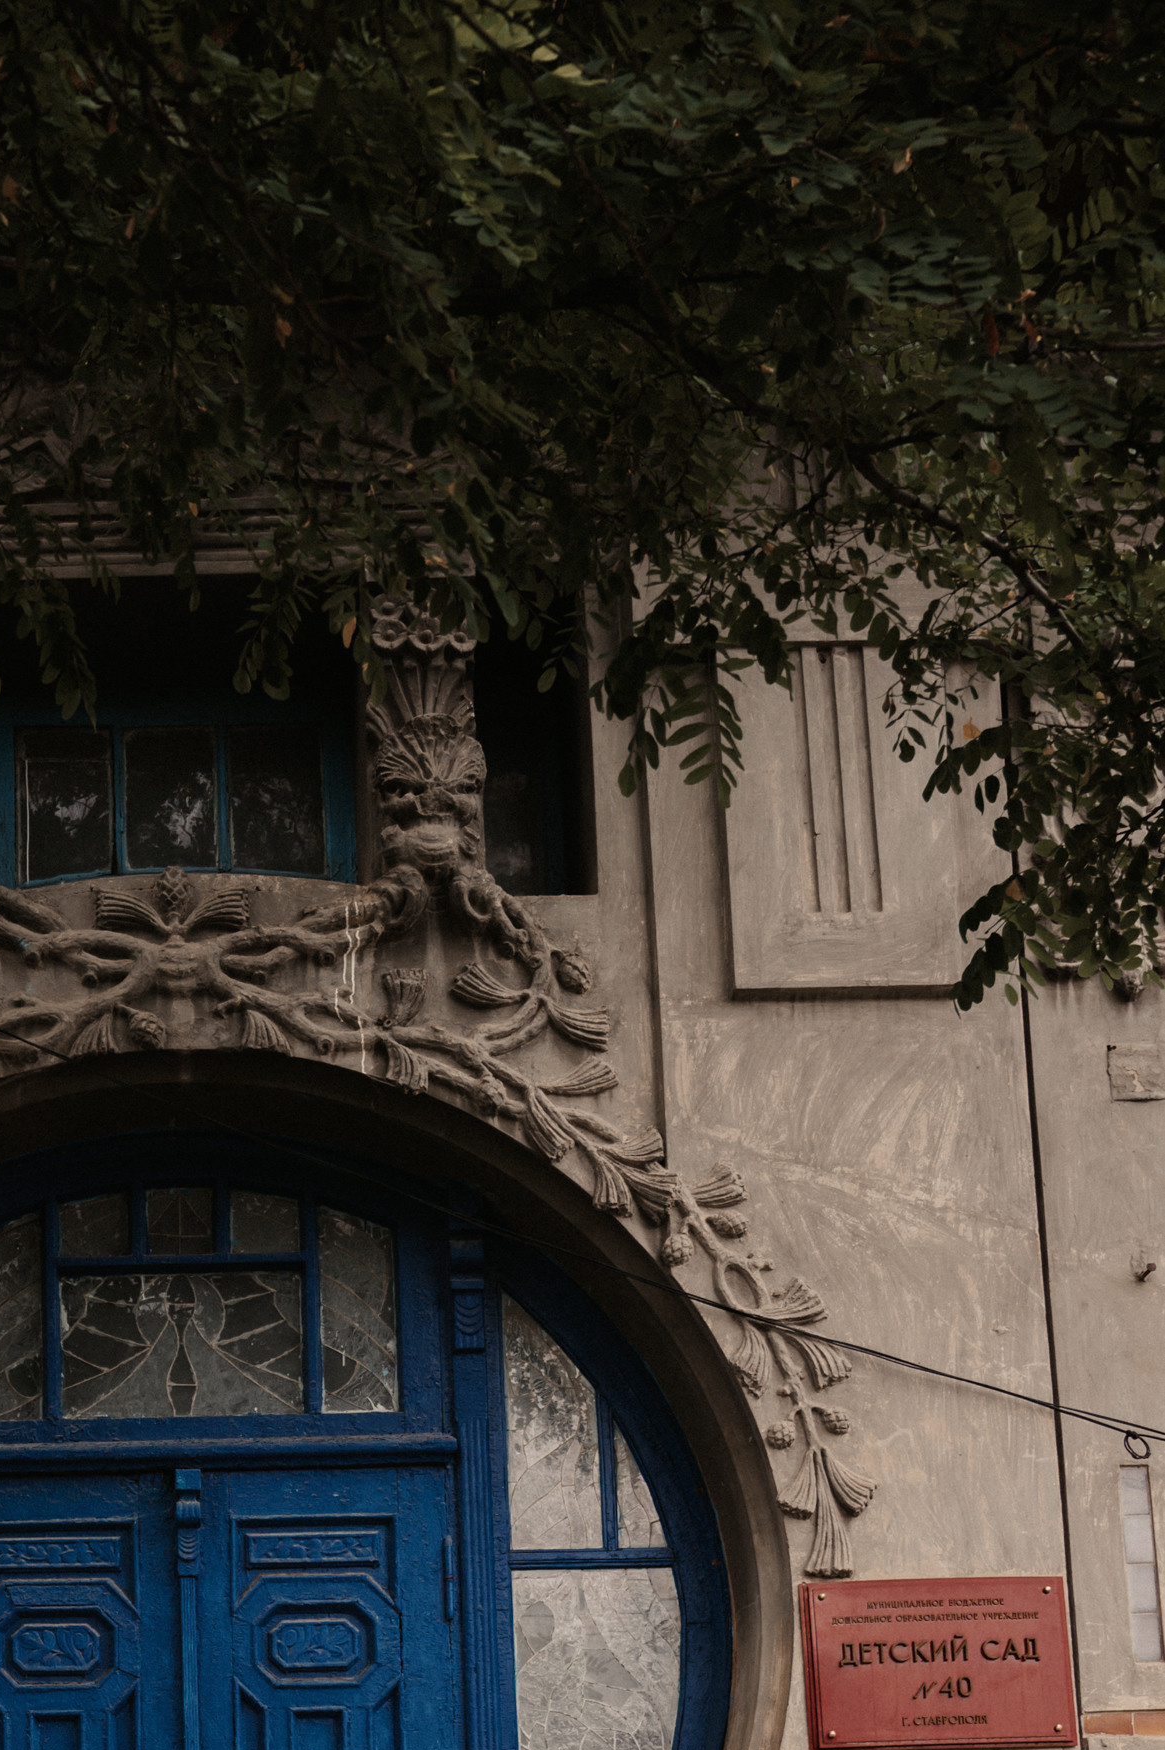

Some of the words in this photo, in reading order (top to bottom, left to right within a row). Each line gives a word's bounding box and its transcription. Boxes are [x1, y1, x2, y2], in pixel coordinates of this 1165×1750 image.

[867, 1600, 944, 1610] МУНИЦИПАЛЬНОЕ
[949, 1598, 1004, 1607] БЮДЖЕТНОЕ
[832, 1616, 891, 1625] ДОШКОЛЬНОЕ
[896, 1614, 978, 1623] ОБРАЗОВАТЕЛЬНОЕ
[983, 1612, 1039, 1620] УЧРЕЖДЕНИЕ
[838, 1634, 968, 1668] ДЕТСКИЙ
[980, 1637, 1040, 1662] САД
[913, 1715, 987, 1726] СТАВРОПОЛЯ
